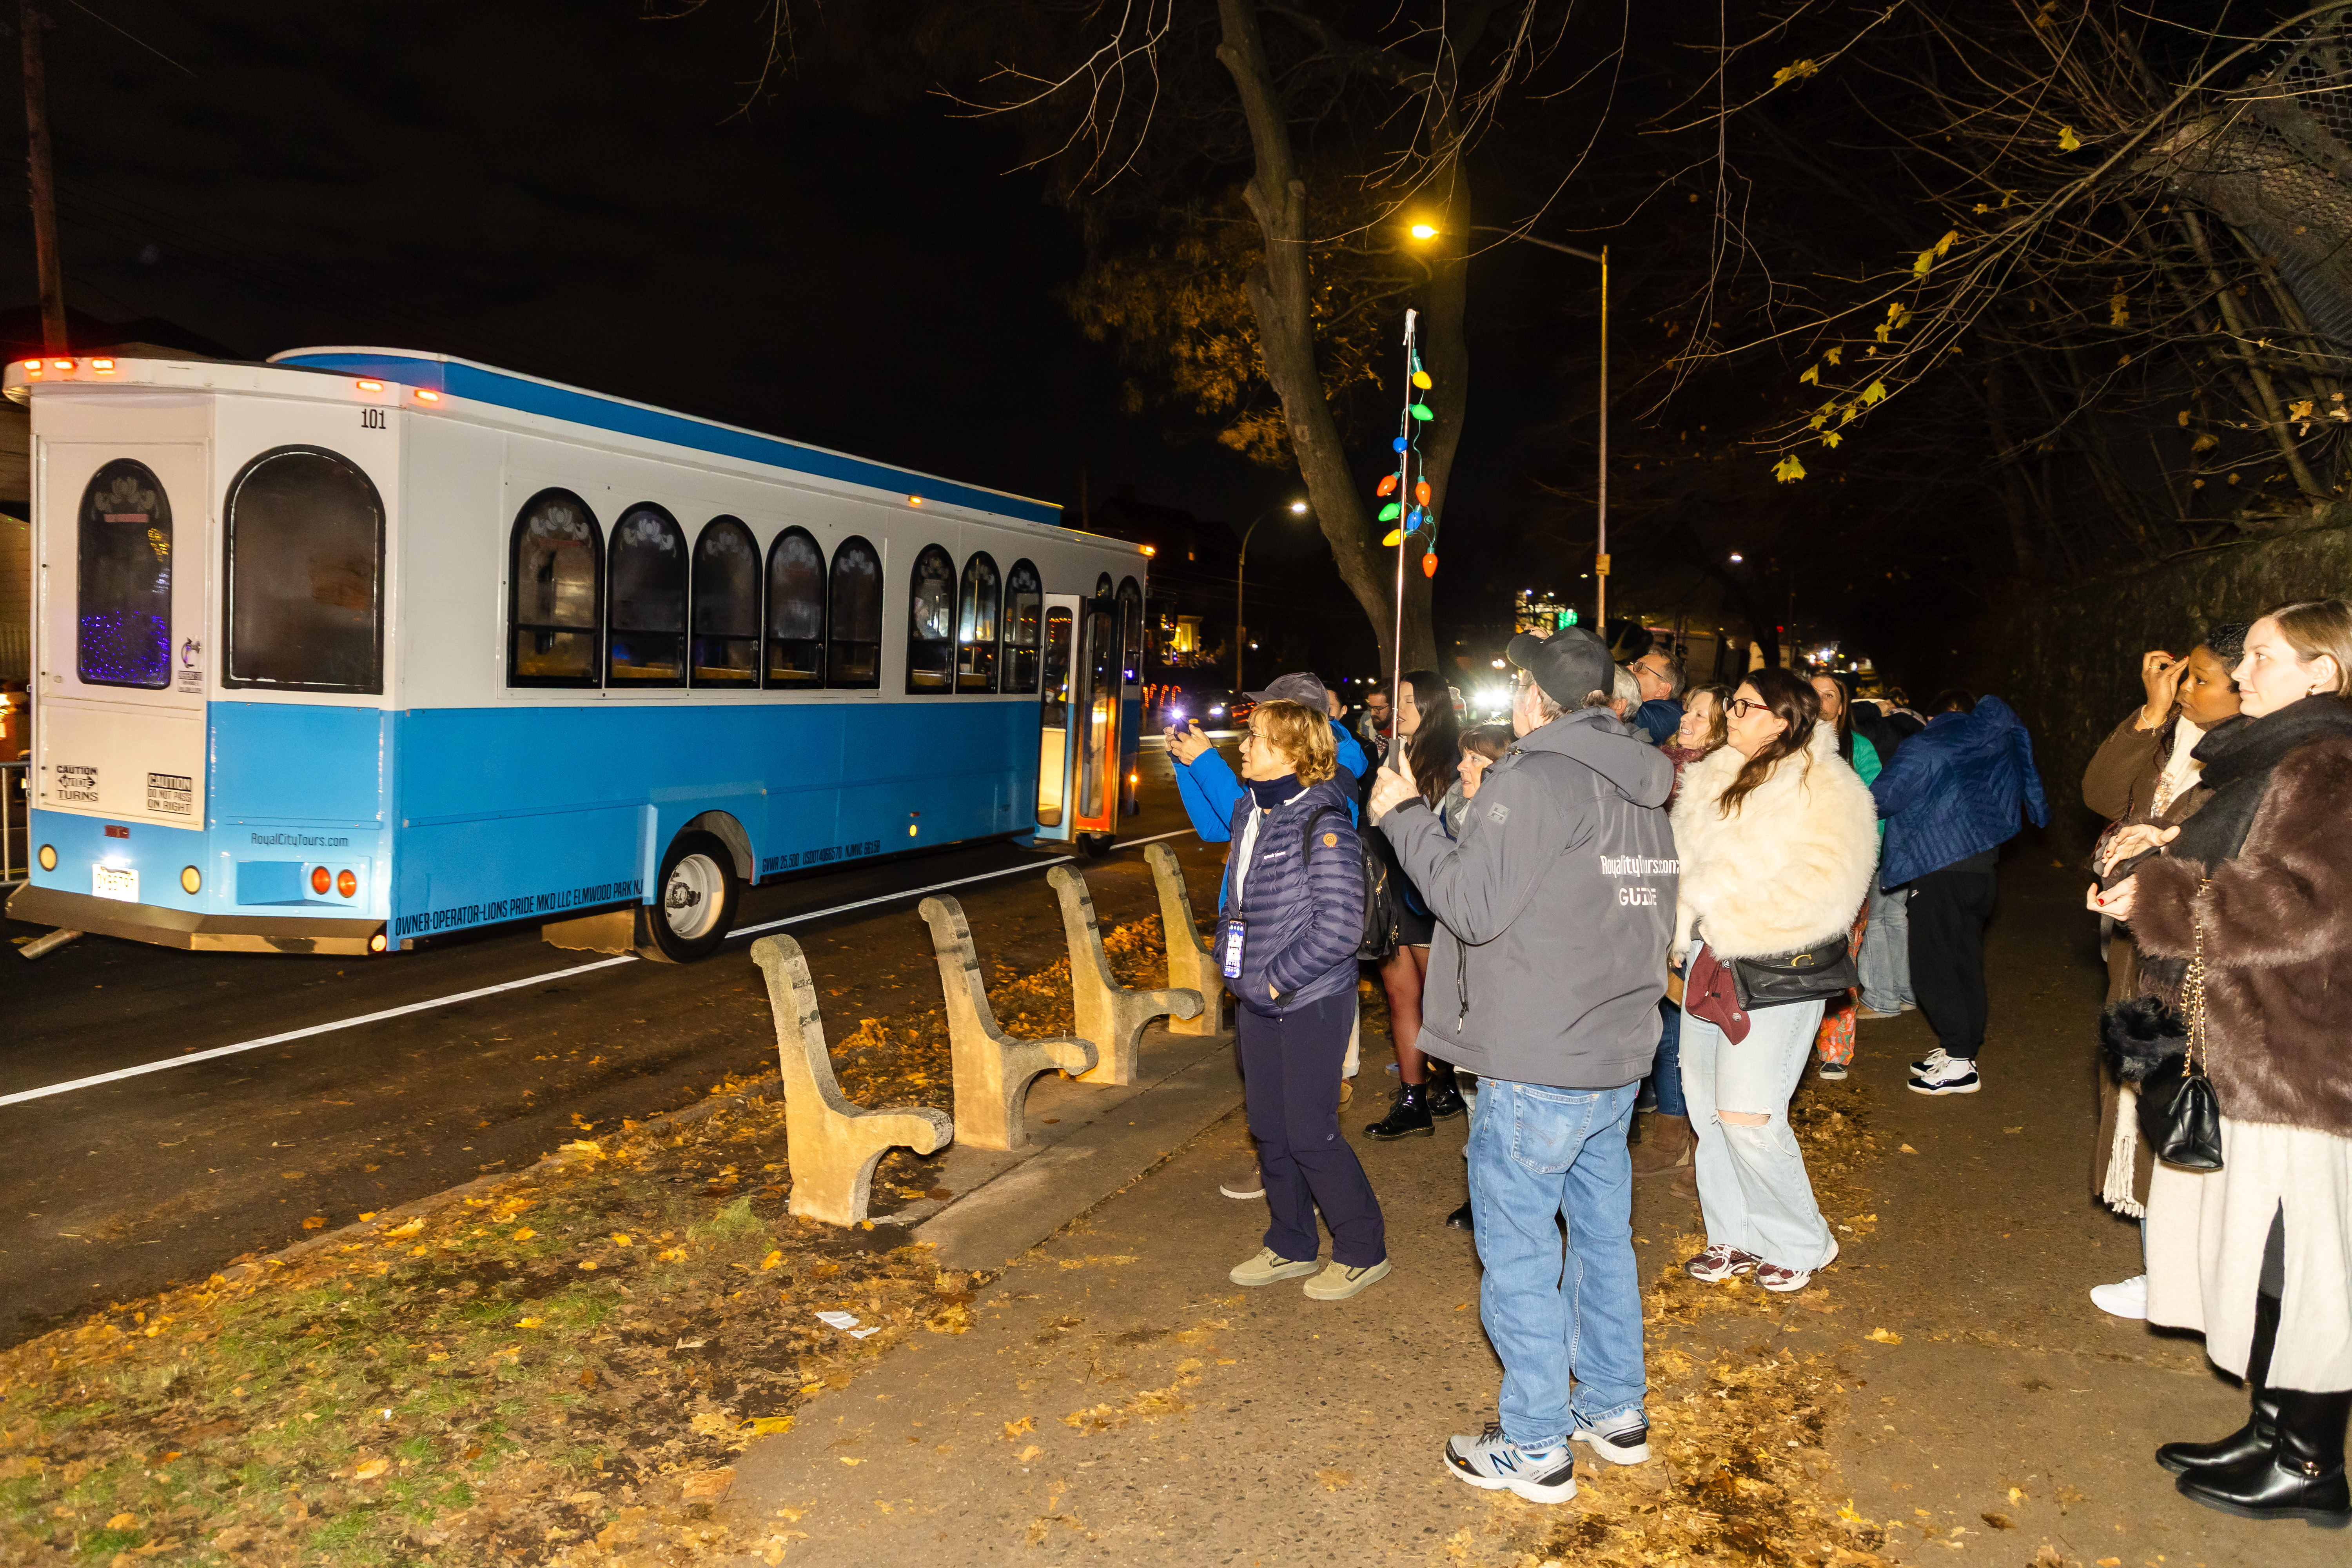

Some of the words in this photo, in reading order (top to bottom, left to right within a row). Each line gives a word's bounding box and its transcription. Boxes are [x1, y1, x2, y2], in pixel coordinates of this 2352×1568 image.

[361, 408, 386, 429] 101
[56, 765, 97, 775] CAUTION
[61, 778, 93, 787] WIDE
[149, 774, 191, 790] CAUTION
[57, 790, 98, 801] TURNS
[148, 788, 157, 798] DO
[159, 789, 172, 799] NOT
[174, 791, 191, 802] PASS
[148, 799, 160, 808] ON
[163, 801, 191, 812] RIGHT
[251, 833, 348, 847] RoyalCityTours.com
[762, 856, 779, 873] GVWR
[780, 853, 800, 869] 25,500
[803, 846, 842, 865] USDOT4066570
[845, 842, 862, 857] NJMVC
[510, 895, 534, 916] PRIDE
[536, 893, 555, 911] MKD
[557, 890, 571, 908] LLC
[573, 884, 612, 906] ELMWOOD
[613, 880, 632, 898] PARK
[633, 879, 643, 895] NJ
[1619, 887, 1657, 906] GUIDE
